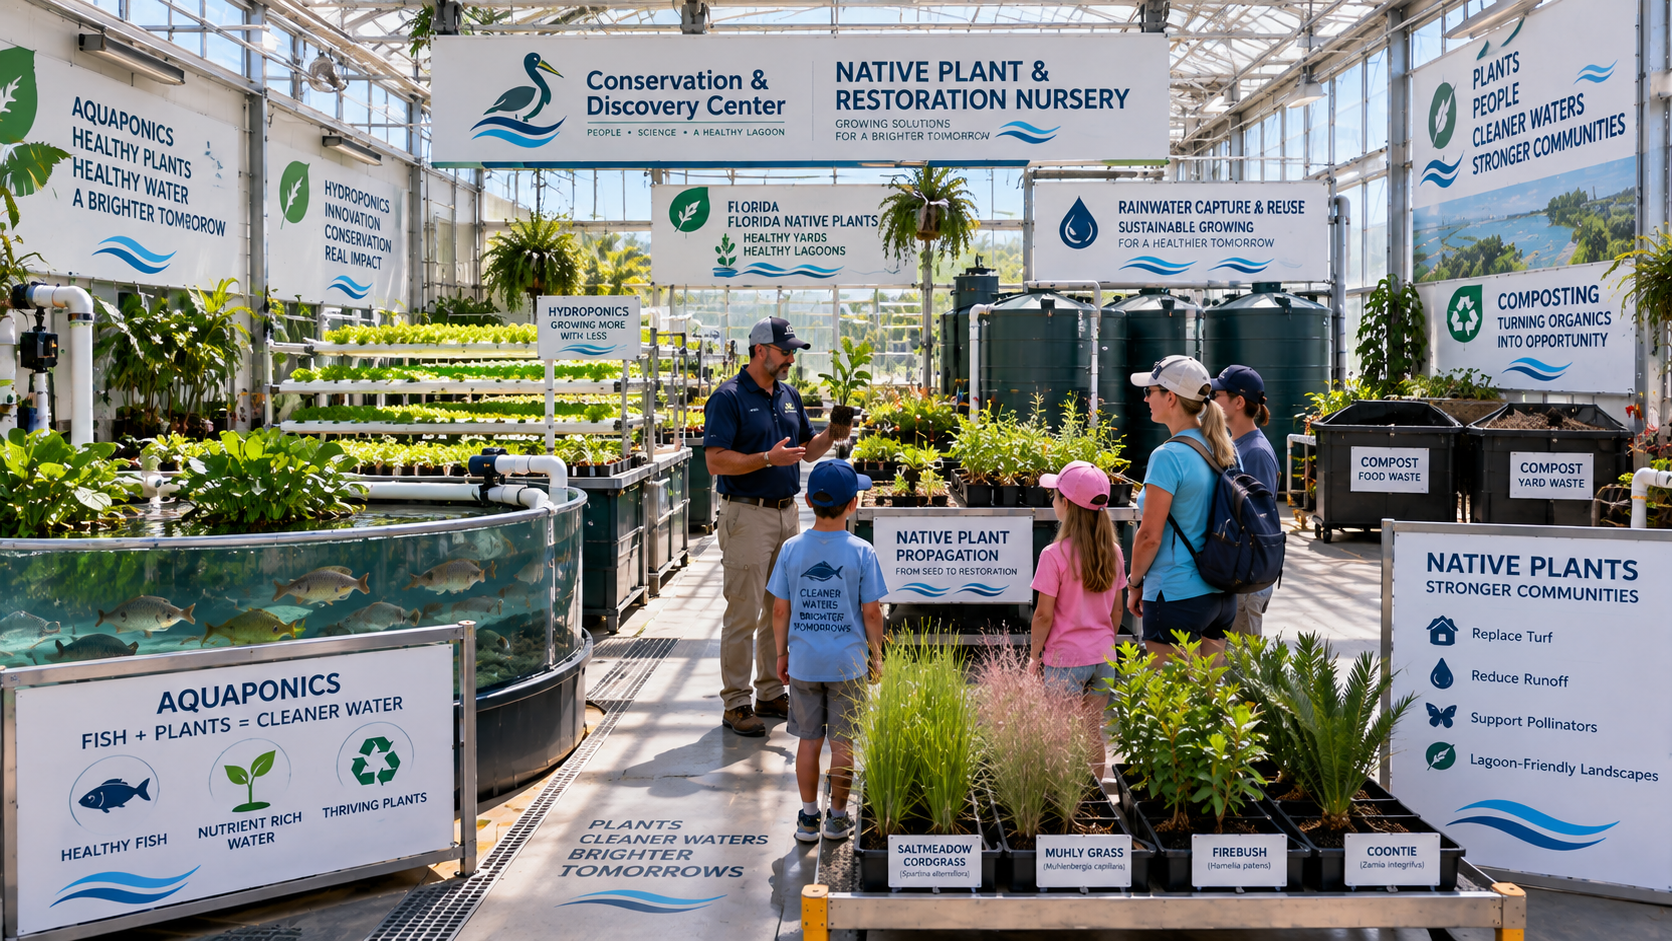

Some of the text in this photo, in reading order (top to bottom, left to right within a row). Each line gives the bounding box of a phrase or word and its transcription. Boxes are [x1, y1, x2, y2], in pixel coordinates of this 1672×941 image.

[837, 60, 1049, 82] NATIVE PLANT &
[1473, 51, 1519, 91] PLANTS
[587, 69, 769, 90] Conservation &
[836, 88, 1130, 110] RESTORATION NURSERY
[1473, 82, 1521, 120] PEOPLE
[587, 95, 786, 121] Discovery Center
[72, 96, 173, 148] AQUAPONICS
[835, 119, 950, 128] GROWING SOLUTIONS
[1473, 93, 1586, 149] CLEANER WATERS
[747, 128, 785, 136] LAGOON
[836, 132, 856, 141] FOR
[861, 132, 868, 140] A
[872, 132, 924, 141] BRIGHTER
[1473, 111, 1627, 175] STRONGER COMMUNITIES
[72, 126, 191, 180] HEALTHY PLANTS
[72, 157, 189, 205] HEALTHY WATER
[325, 180, 389, 215] HYDROPONICS
[73, 188, 83, 208] A
[89, 191, 155, 222] BRIGHTER
[728, 201, 779, 213] FLORIDA
[1119, 200, 1305, 214] RAINWATER CAPTURE & REUSE
[325, 202, 381, 232] INNOVATION
[728, 215, 879, 227] FLORIDA NATIVE PLANTS
[1119, 221, 1254, 233] SUSTAINABLE GROWING
[325, 224, 391, 255] CONSERVATION
[744, 233, 827, 243] HEALTHY YARDS
[1119, 238, 1274, 248] FOR A HEALTHIER TOMORROW
[325, 246, 383, 270] REAL IMPACT
[744, 246, 846, 256] HEALTHY LAGOONS
[1498, 285, 1601, 312] COMPOSTING
[549, 307, 629, 317] HYDROPONICS
[551, 321, 625, 329] GROWING MORE
[1497, 311, 1611, 330] TURNING ORGANICS
[587, 332, 607, 340] LESS
[1498, 333, 1608, 348] INTO OPPORTUNITY
[1361, 457, 1419, 468] COMPOST
[1520, 462, 1583, 474] COMPOST
[1359, 472, 1421, 481] FOOD WASTE
[1518, 478, 1584, 488] YARD WASTE
[897, 531, 1010, 544] NATIVE PLANT
[897, 549, 998, 561] PROPAGATION
[922, 567, 943, 575] SEED
[1427, 552, 1638, 581] NATIVE PLANTS
[800, 588, 841, 598] CLEANER
[1426, 580, 1639, 603] STRONGER COMMUNITIES
[1473, 628, 1553, 643] Replace Turf
[1472, 670, 1569, 687] Reduce Runoff
[155, 671, 340, 715] AQUAPONICS
[82, 696, 403, 749] FISH + PLANTS = CLEANER WATER
[1471, 712, 1597, 733] Support Pollinators
[1471, 753, 1658, 782] Lagoon-Friendly Landscapes
[322, 792, 427, 818] THRIVING PLANTS
[199, 811, 301, 839] NUTRIENT RICH
[588, 820, 683, 830] PLANTS
[228, 831, 274, 850] WATER
[579, 834, 768, 845] CLEANER WATERS
[62, 833, 167, 861] HEALTHY FISH
[898, 844, 972, 854] SALTMEADOW
[1046, 848, 1123, 858] MUHLY GRASS
[1213, 847, 1267, 857] FIREBUSH
[1367, 846, 1417, 856] COONTIE
[568, 849, 693, 860] BRIGHTER
[904, 858, 966, 866] CORDGRASS
[1208, 862, 1271, 871] (Hamelia patens)
[558, 865, 745, 878] TOMORROWS
